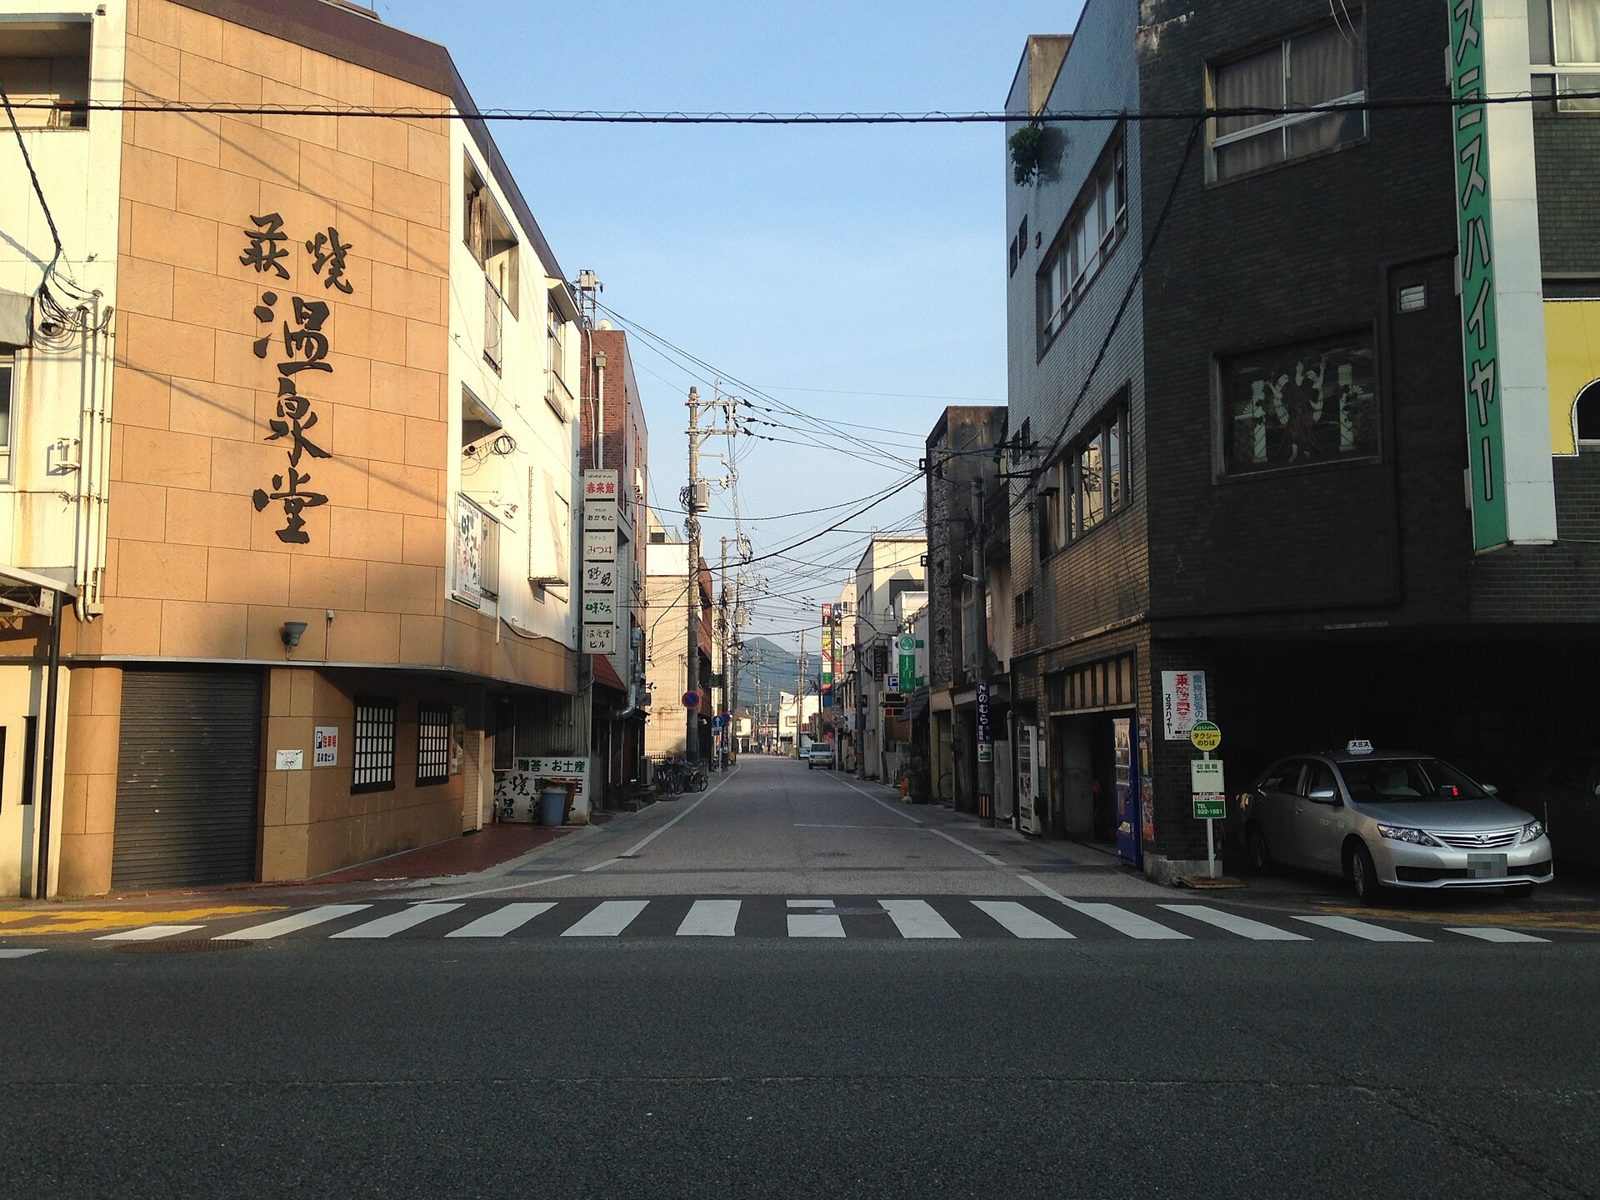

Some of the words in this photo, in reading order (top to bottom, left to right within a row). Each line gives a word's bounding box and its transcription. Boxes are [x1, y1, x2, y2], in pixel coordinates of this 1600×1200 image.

[1455, 0, 1496, 500] スミスハイヤー
[252, 290, 334, 544] 温泉堂
[589, 641, 605, 649] ビル
[1165, 693, 1173, 735] スミスハイヤー
